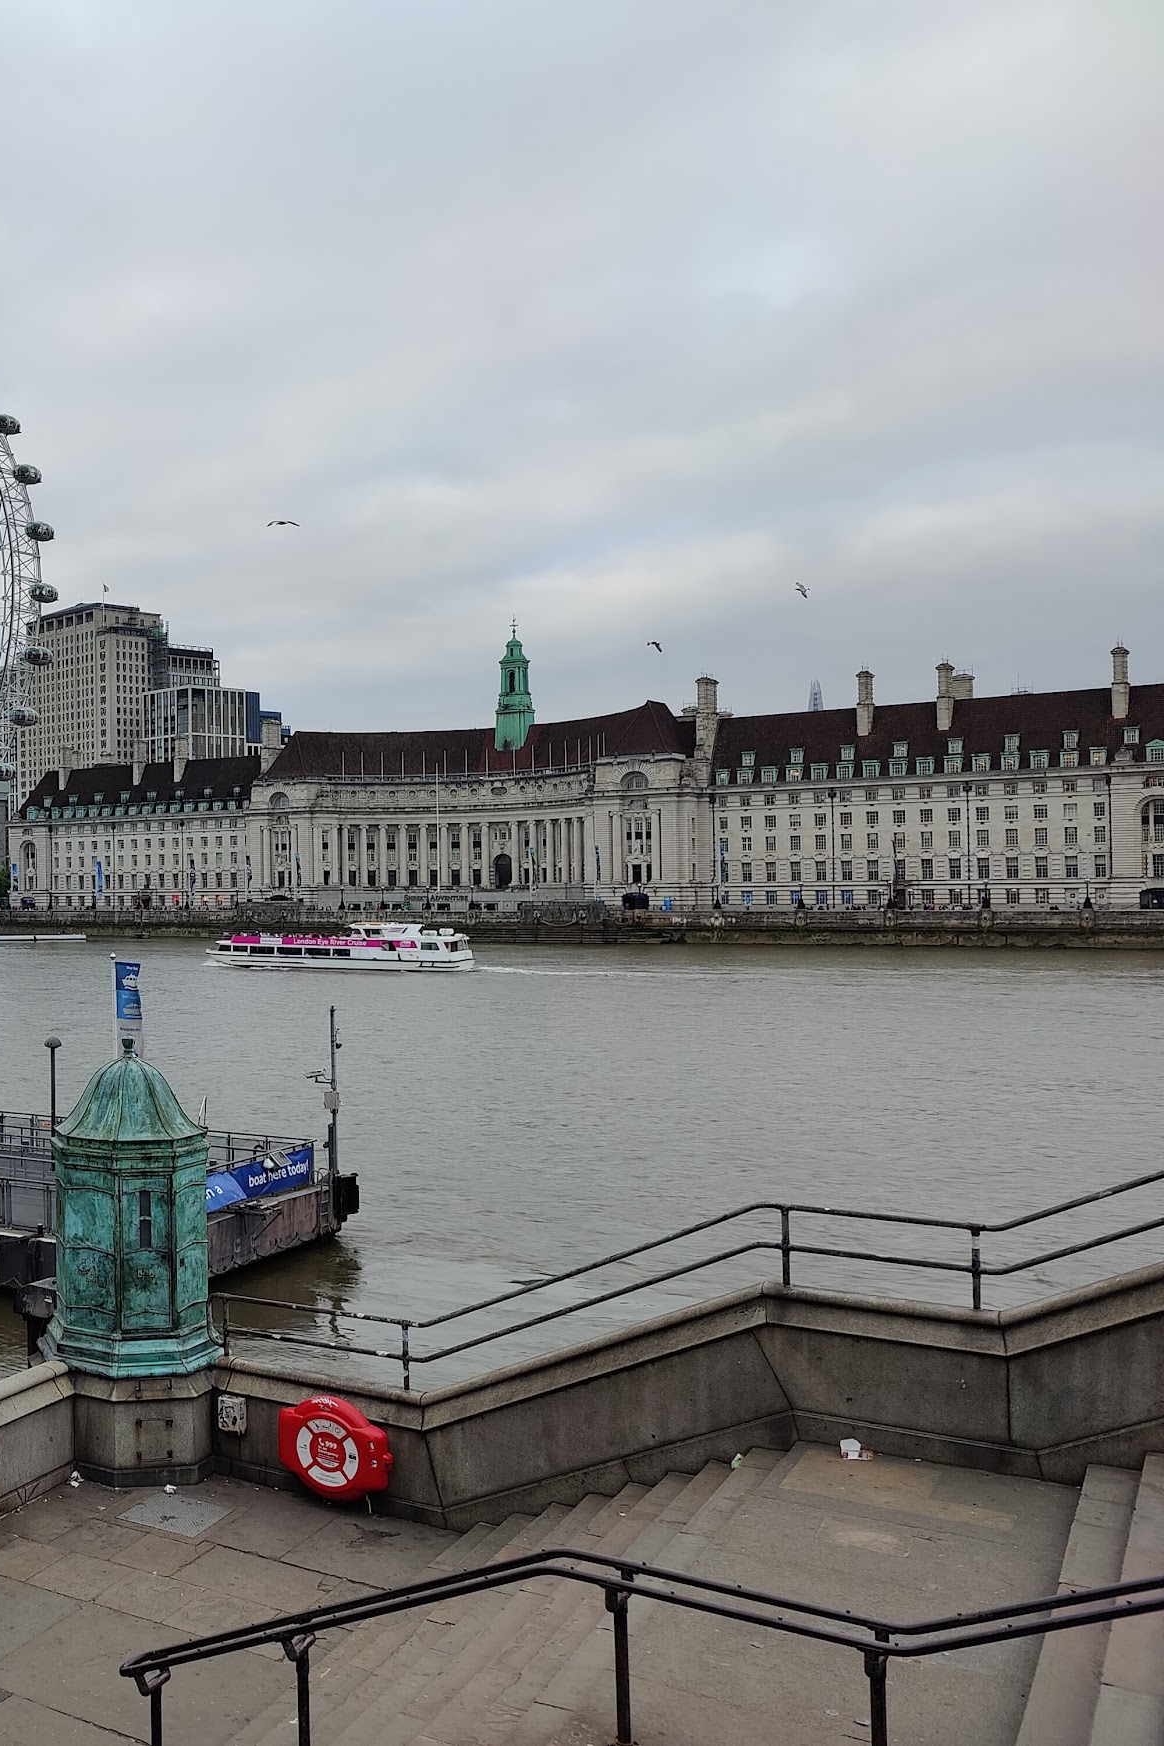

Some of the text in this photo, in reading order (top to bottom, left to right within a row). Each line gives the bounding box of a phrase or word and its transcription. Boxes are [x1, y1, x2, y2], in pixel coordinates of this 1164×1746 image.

[430, 894, 468, 902] ADVENTURE
[317, 939, 329, 947] Eye
[248, 1159, 309, 1188] boat here today!
[206, 1185, 224, 1200] n a
[324, 1440, 338, 1450] 999
